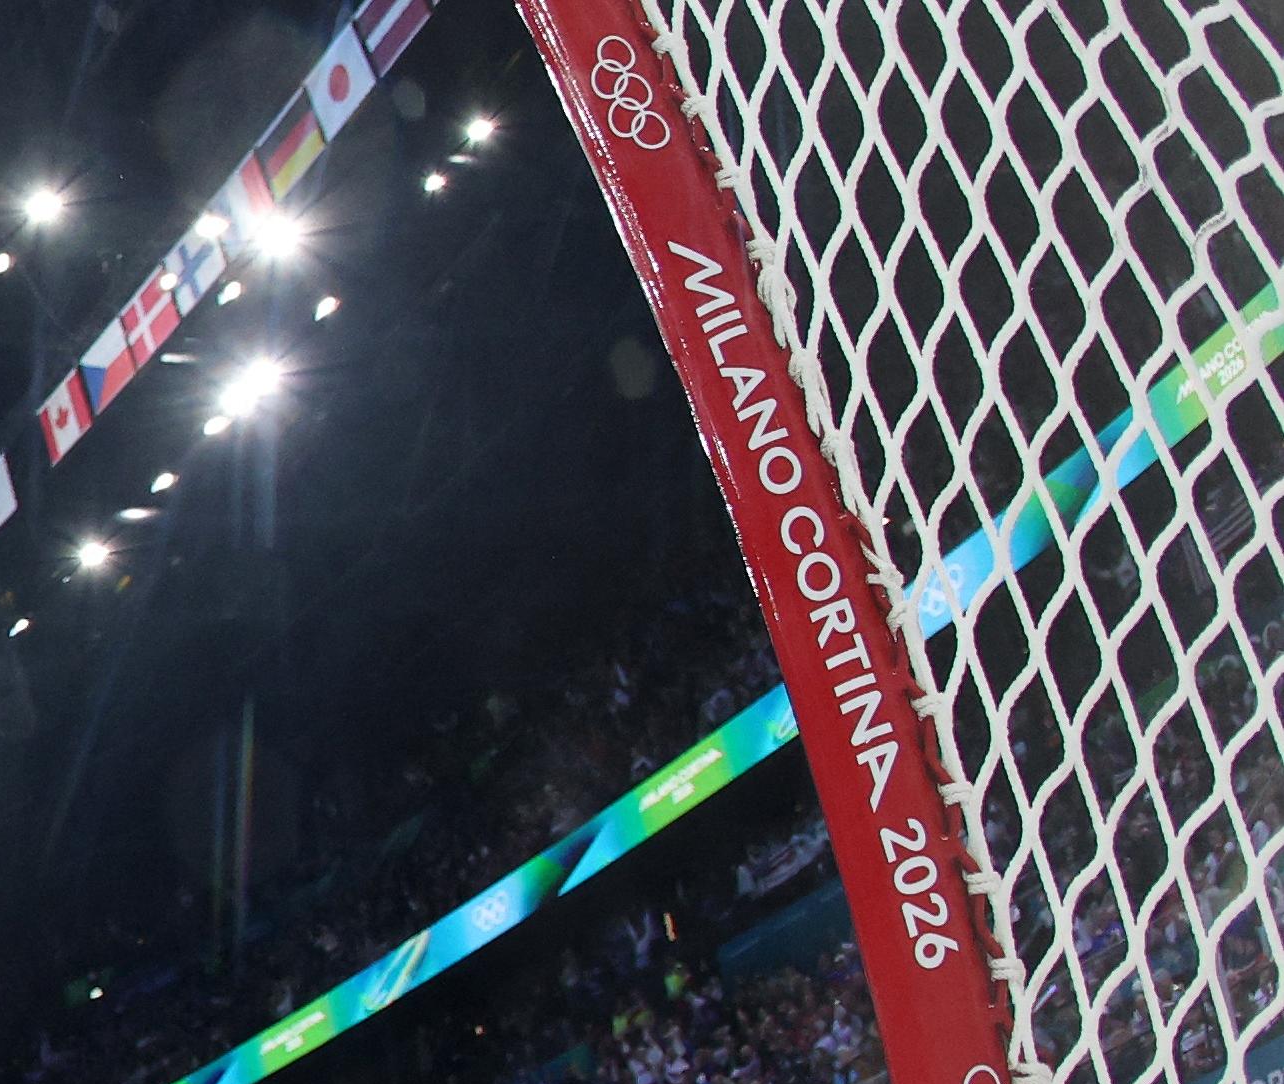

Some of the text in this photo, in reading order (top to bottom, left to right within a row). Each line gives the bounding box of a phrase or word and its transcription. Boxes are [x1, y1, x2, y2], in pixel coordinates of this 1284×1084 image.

[667, 241, 959, 970] MILANO CORTINA 2026
